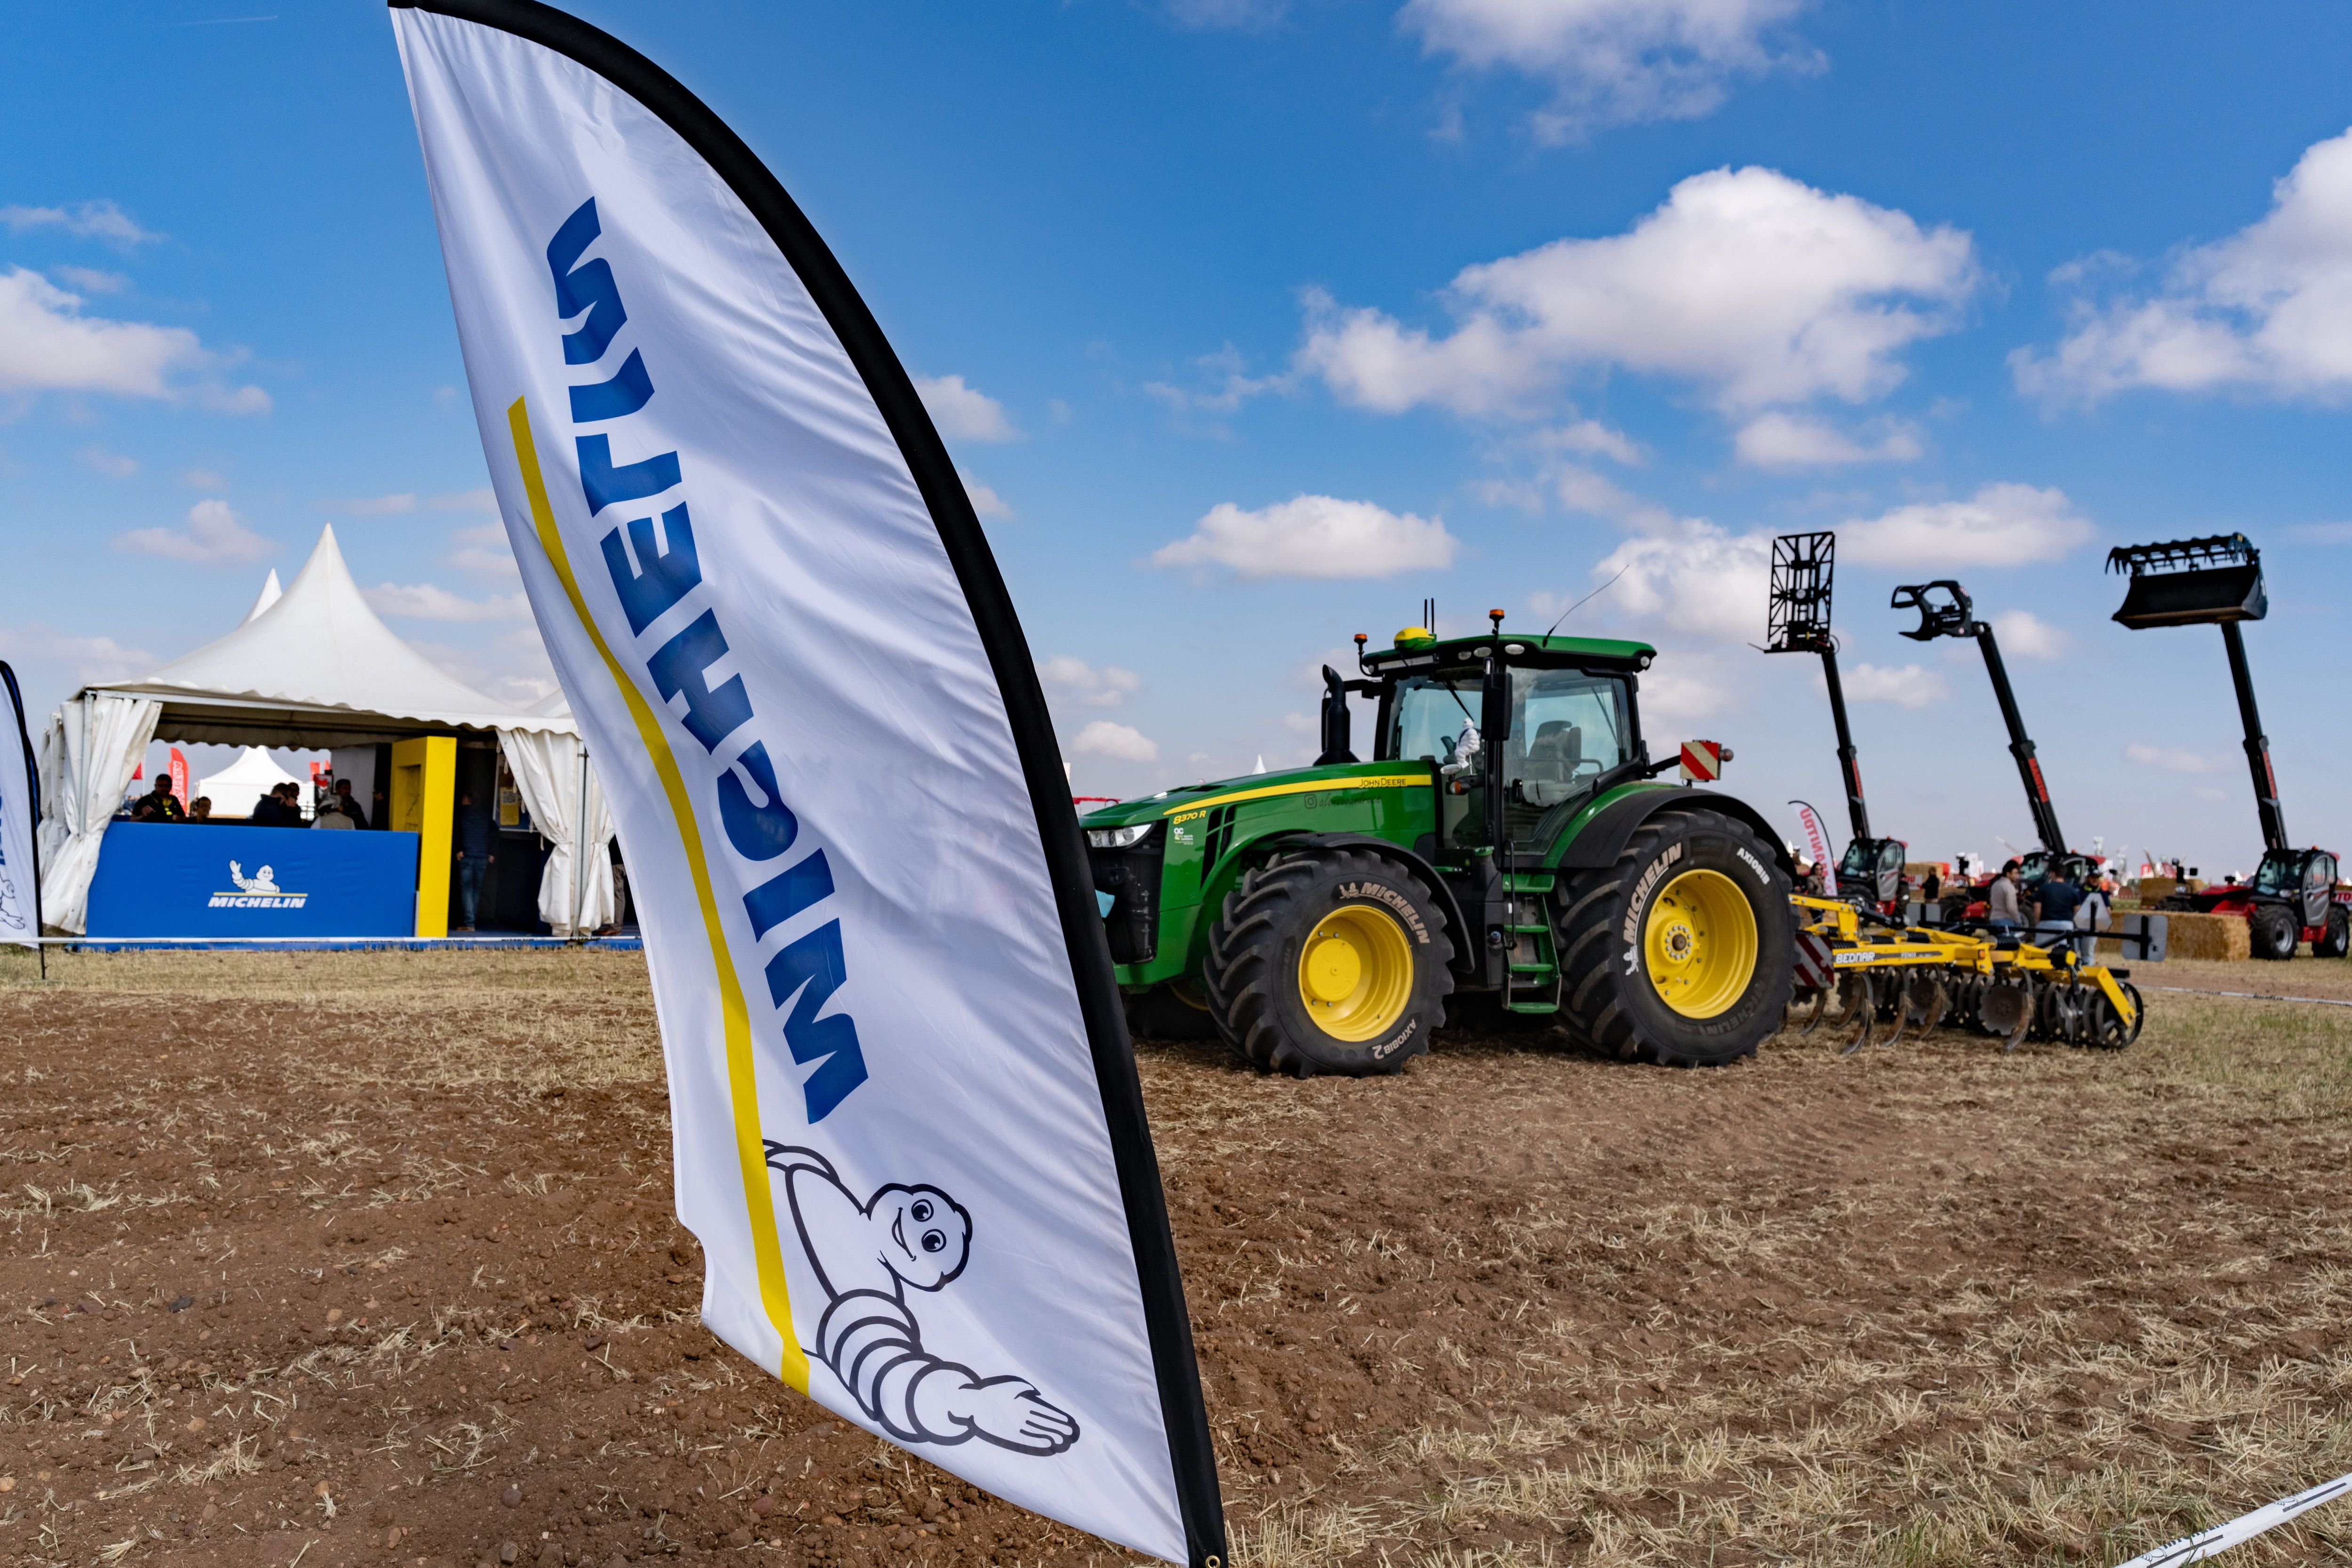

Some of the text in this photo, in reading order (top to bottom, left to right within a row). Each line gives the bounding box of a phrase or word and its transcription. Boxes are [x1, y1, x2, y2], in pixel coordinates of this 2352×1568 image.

[1173, 810, 1207, 825] 8370 R
[1736, 847, 1770, 885] AXIOBIB
[207, 896, 307, 908] MICHELIN
[1623, 842, 1682, 945] MICHELIN
[1360, 882, 1430, 944] MICHELIN
[1836, 951, 1875, 963] BEDNAR
[1372, 1019, 1416, 1059] AXIOBIB 2
